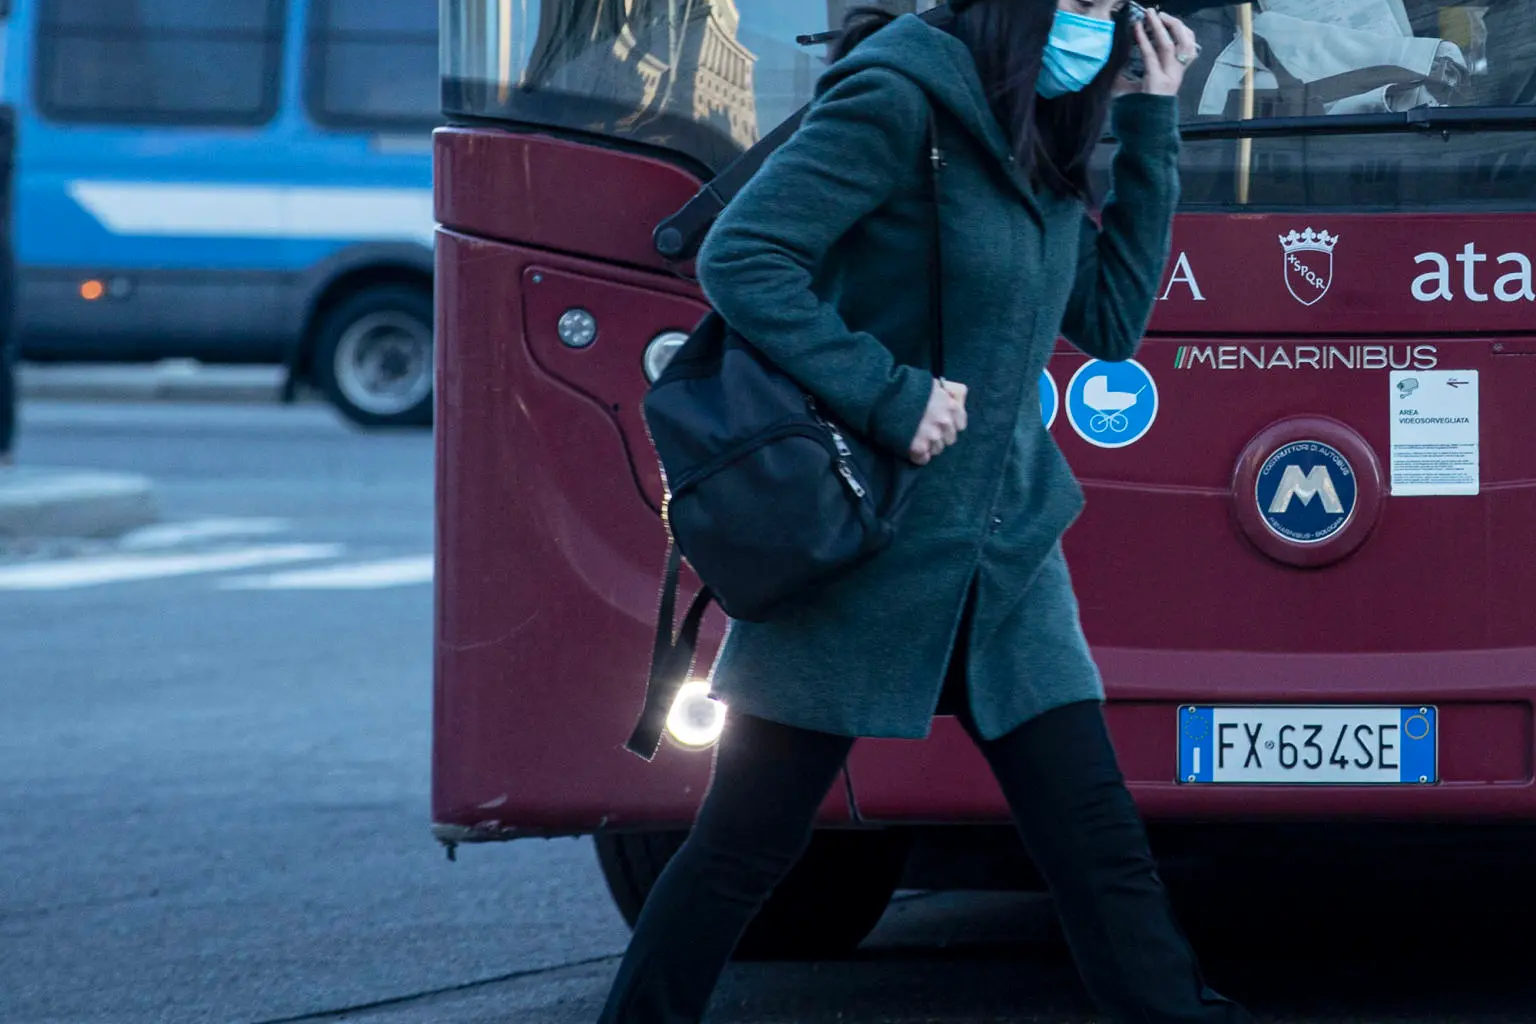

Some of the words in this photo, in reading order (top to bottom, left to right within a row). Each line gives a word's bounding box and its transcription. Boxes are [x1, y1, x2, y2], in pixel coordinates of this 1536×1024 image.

[1153, 251, 1207, 301] A
[1187, 345, 1438, 370] MENARINIBUS
[1398, 417, 1470, 425] VIDEOSORVEGLIATA
[1268, 465, 1344, 513] M
